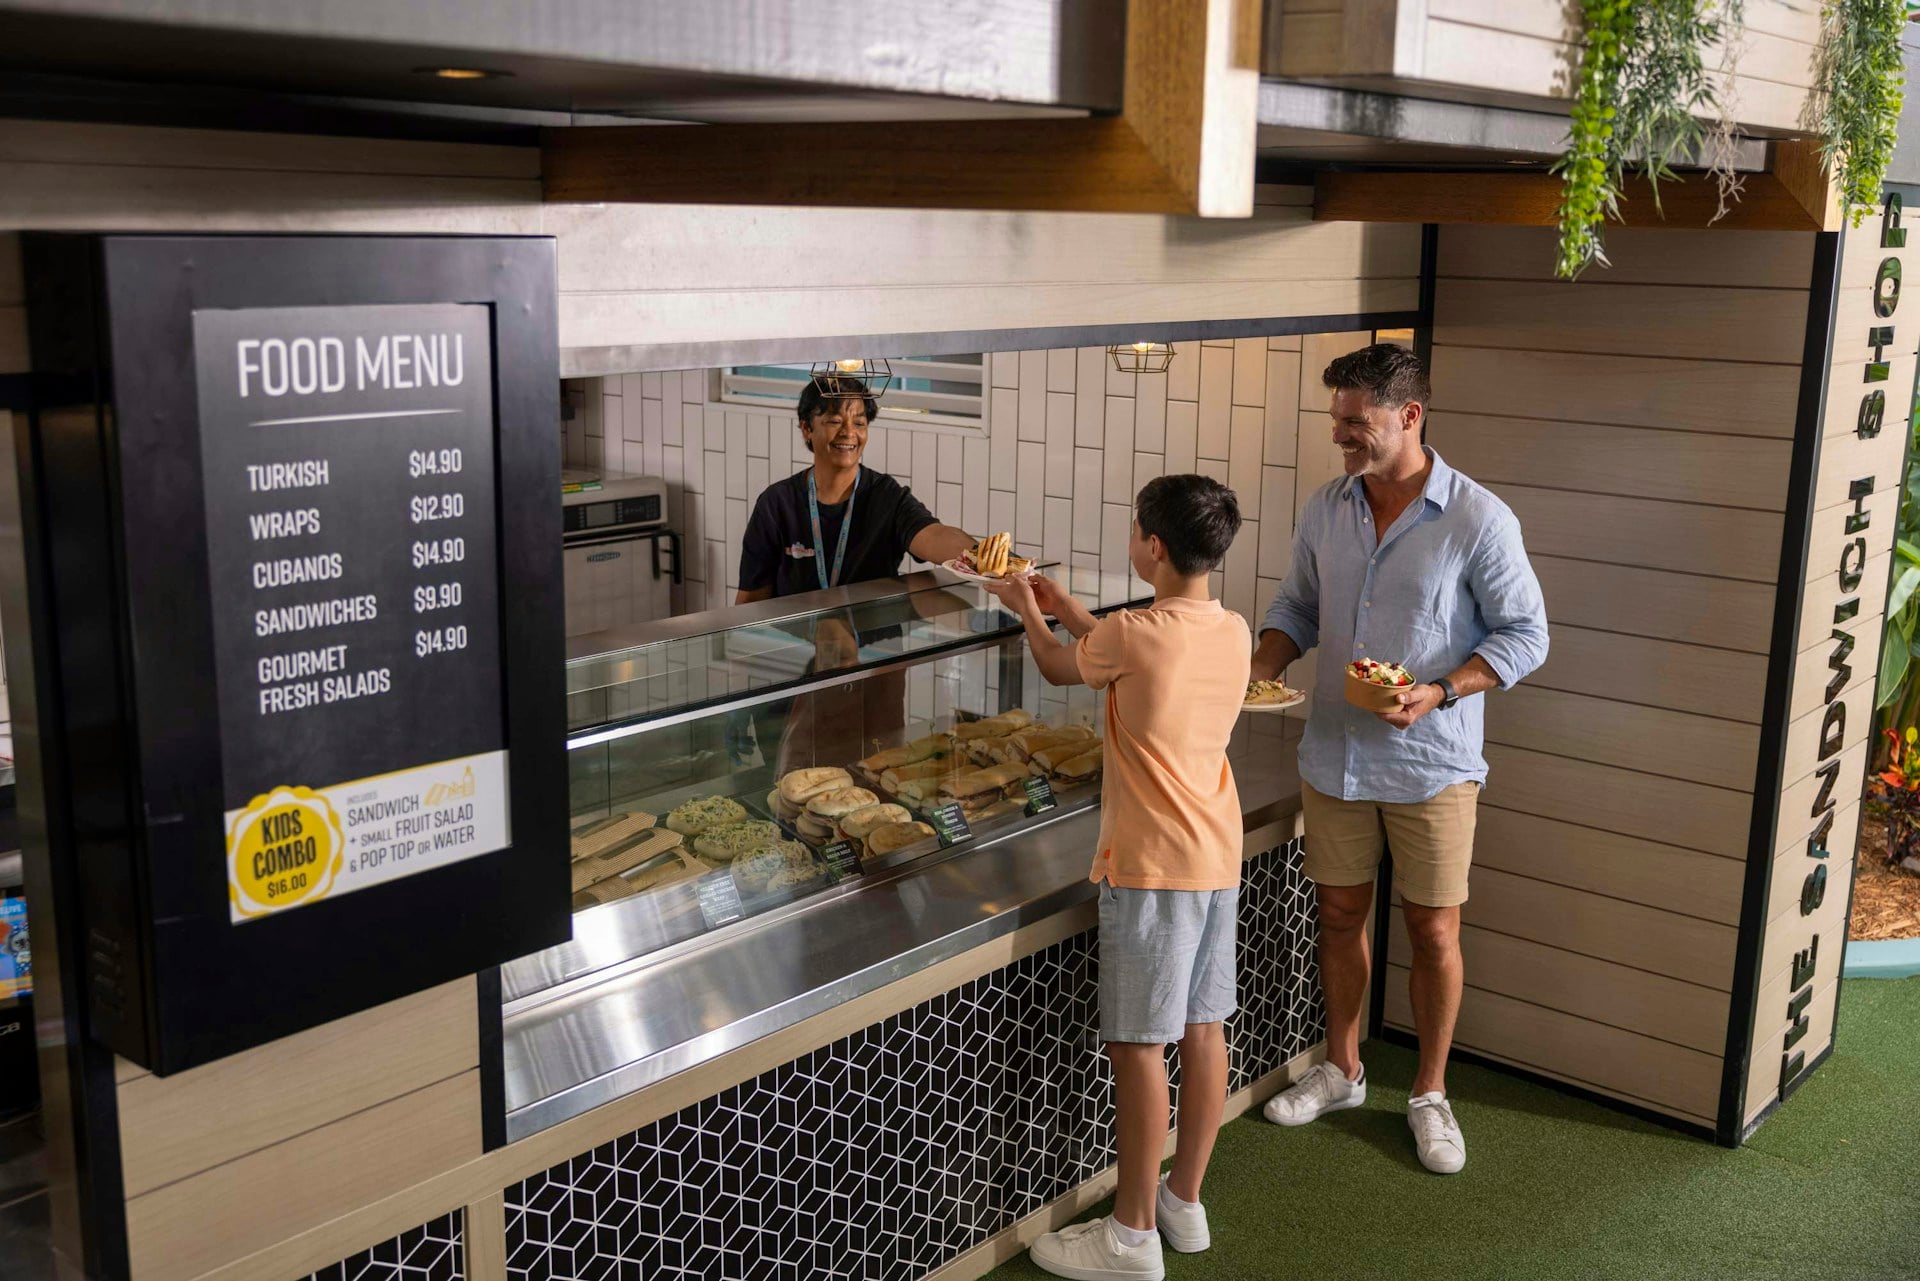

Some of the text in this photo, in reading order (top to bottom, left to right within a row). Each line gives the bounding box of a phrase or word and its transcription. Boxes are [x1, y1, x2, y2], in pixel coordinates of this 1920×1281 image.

[237, 333, 464, 398] FOOD MENU
[247, 448, 462, 492] TURKISH $14.90
[249, 493, 464, 540] WRAPS $12.90
[253, 537, 465, 589] CUBANOS $14.90
[255, 582, 462, 637] SANDWICHES $9.90
[258, 625, 468, 684] GOURMET $14.90
[1780, 192, 1907, 1102] THE SANDWICH SHOP
[260, 668, 391, 716] FRESH SALADS
[262, 809, 303, 847] KIDS
[348, 794, 420, 827] SANDWICH
[361, 828, 393, 847] SMALL
[395, 813, 431, 838] FRUIT
[434, 803, 473, 828] SALAD
[253, 836, 316, 880] COMBO
[350, 825, 475, 873] & POP TOP OR WATER
[267, 872, 307, 898] $16.00
